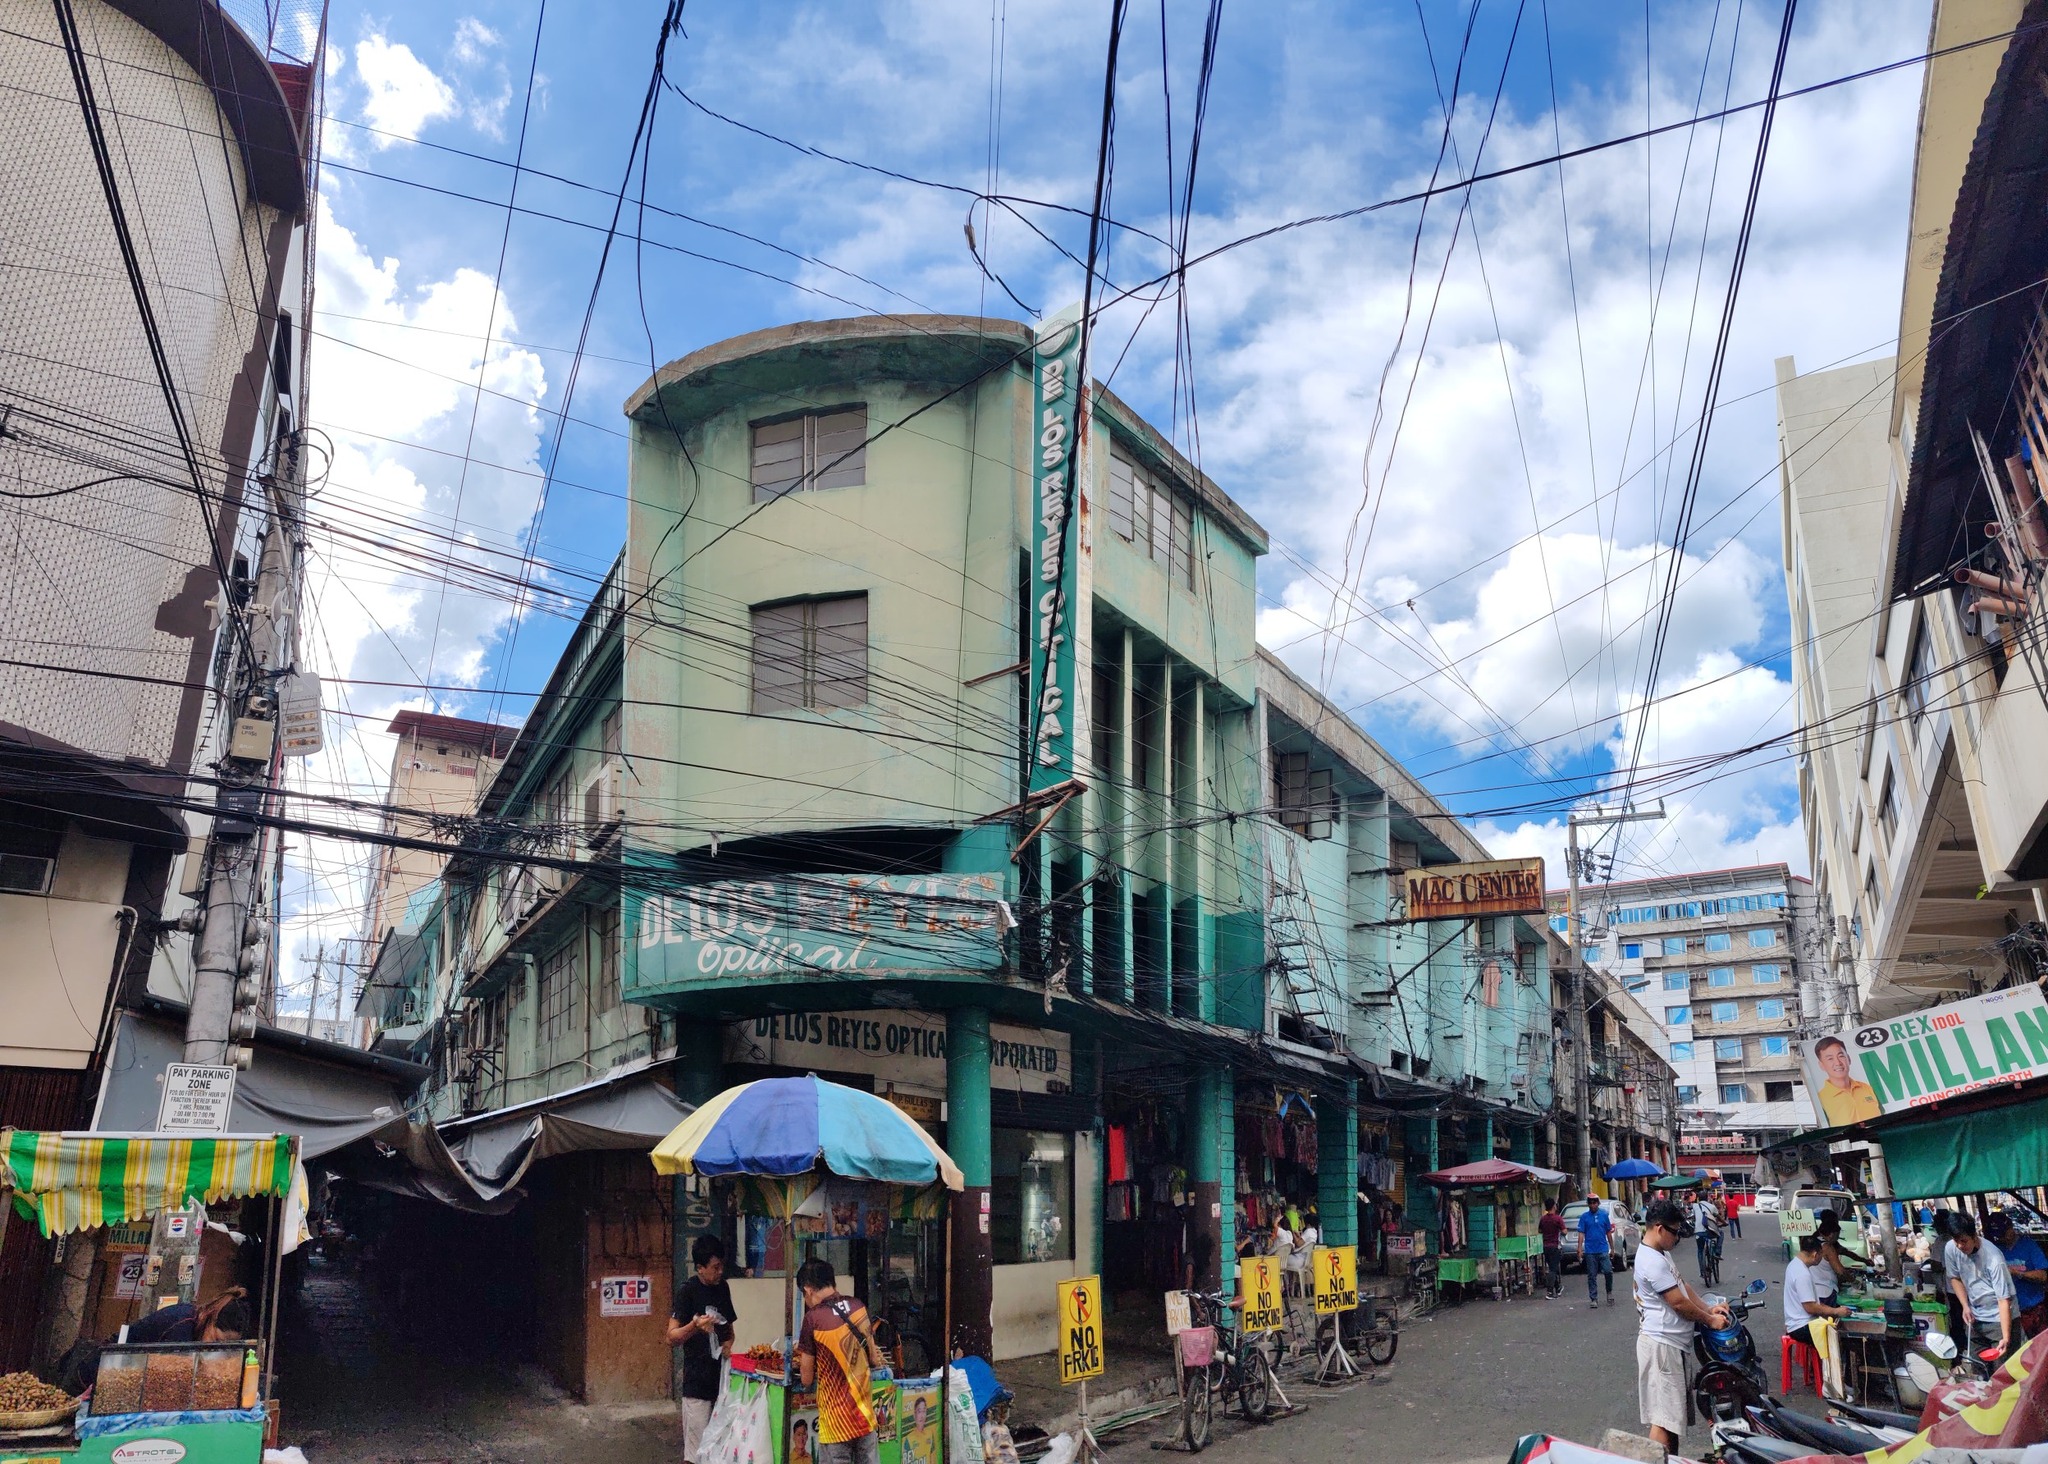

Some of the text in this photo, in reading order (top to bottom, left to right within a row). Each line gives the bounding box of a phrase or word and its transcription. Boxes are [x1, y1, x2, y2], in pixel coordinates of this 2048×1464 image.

[1042, 359, 1066, 404] DE
[1040, 408, 1066, 469] LOS
[1040, 470, 1065, 582] REYES
[1037, 588, 1065, 768] OPTICAL
[1409, 871, 1539, 907] MAC CENTER
[640, 875, 1000, 950] DE LOS REYES
[756, 1014, 780, 1038] DE
[784, 1012, 822, 1045] LOS
[827, 1016, 881, 1053] REYES
[886, 1023, 947, 1060] OPTICA
[1860, 1012, 1965, 1047] 23 REX IDOL
[1858, 1006, 2048, 1105] MILLAN
[172, 1068, 230, 1080] PAY PARKING
[188, 1079, 211, 1089] ZONE
[1787, 1210, 1802, 1220] NO
[1781, 1222, 1812, 1232] PARKING
[125, 1267, 139, 1278] 23
[615, 1280, 648, 1298] TGP
[1330, 1277, 1344, 1293] NO
[1257, 1292, 1271, 1309] NO
[1317, 1290, 1355, 1309] PARKING
[1070, 1326, 1095, 1352] NO
[114, 1448, 182, 1457] ASTROTEL
